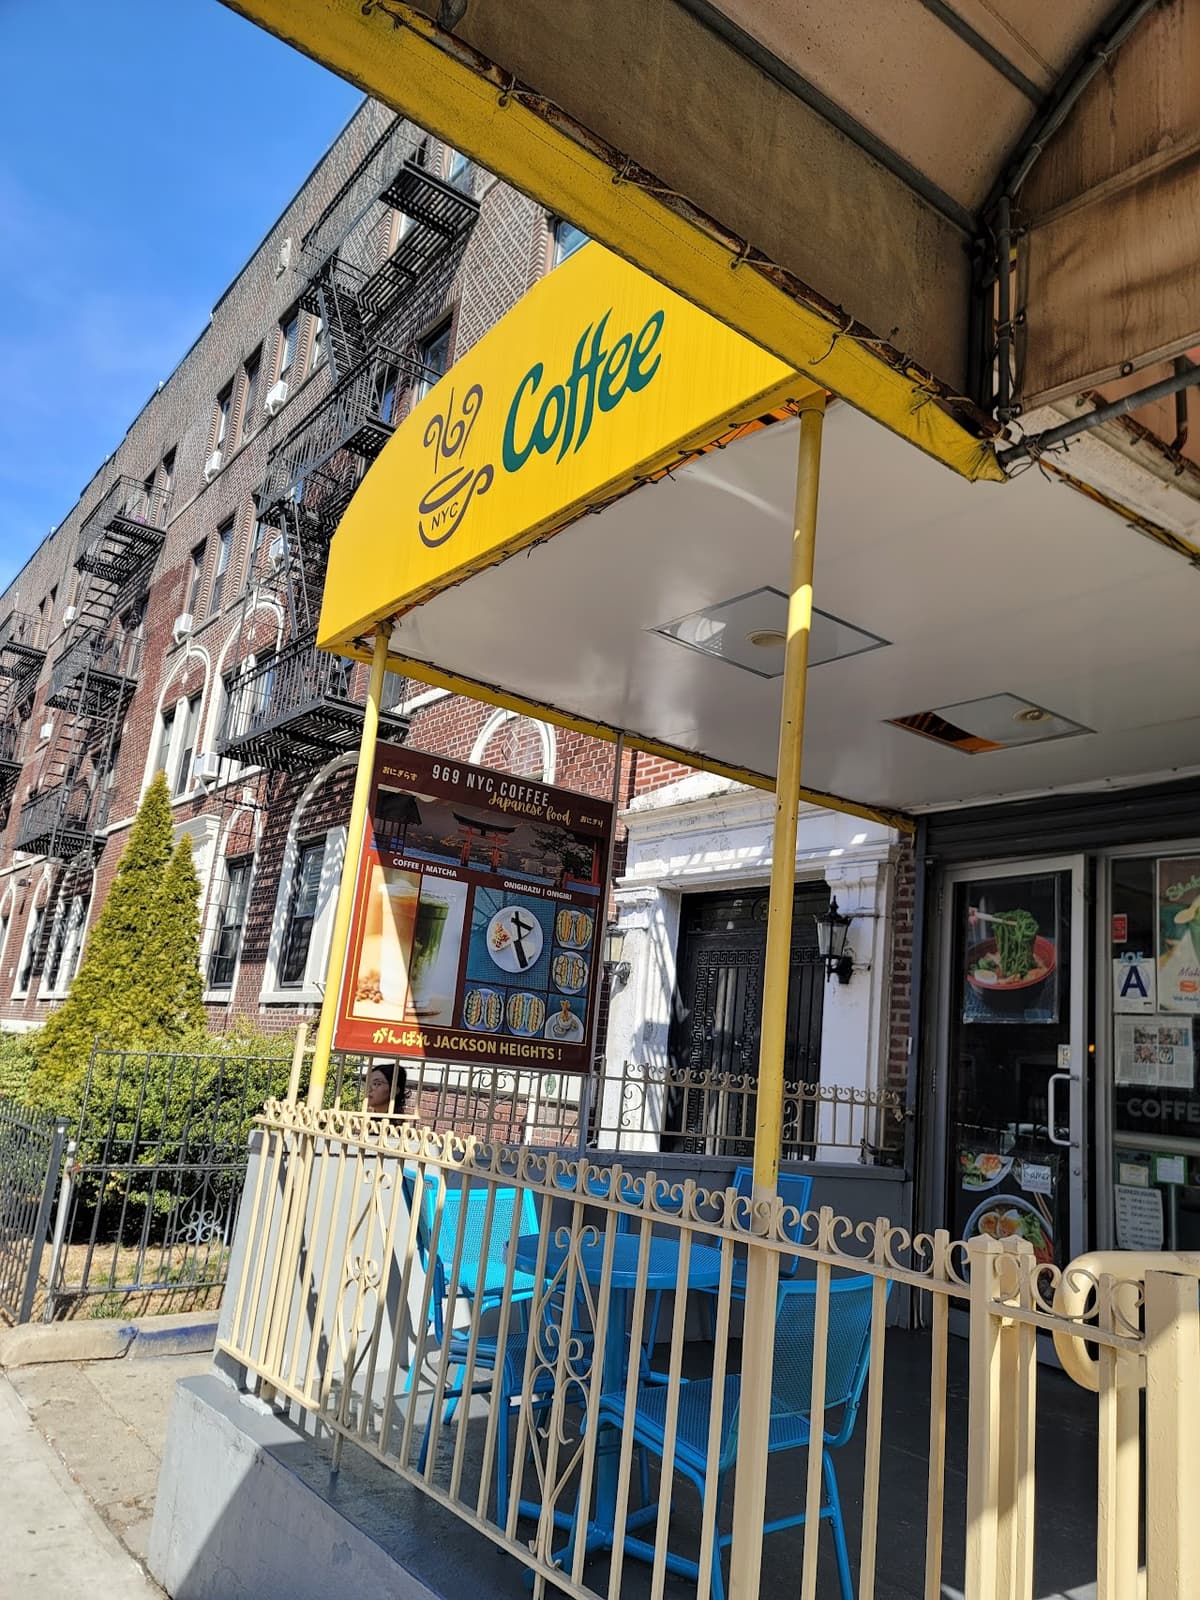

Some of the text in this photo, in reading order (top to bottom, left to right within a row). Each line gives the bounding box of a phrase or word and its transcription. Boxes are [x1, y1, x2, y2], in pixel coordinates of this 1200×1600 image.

[502, 306, 665, 473] Coffee
[423, 383, 484, 474] 969
[431, 502, 459, 530] NYC
[431, 764, 549, 807] 969 NYC COFFEE
[488, 791, 572, 826] Japanese food
[392, 858, 457, 878] COFFEE MATCHA
[504, 881, 572, 901] ONIGIRAZU ONIGIRI
[1120, 965, 1148, 998] A
[433, 1035, 497, 1054] JACKSON
[499, 1042, 555, 1060] HEIGHTS
